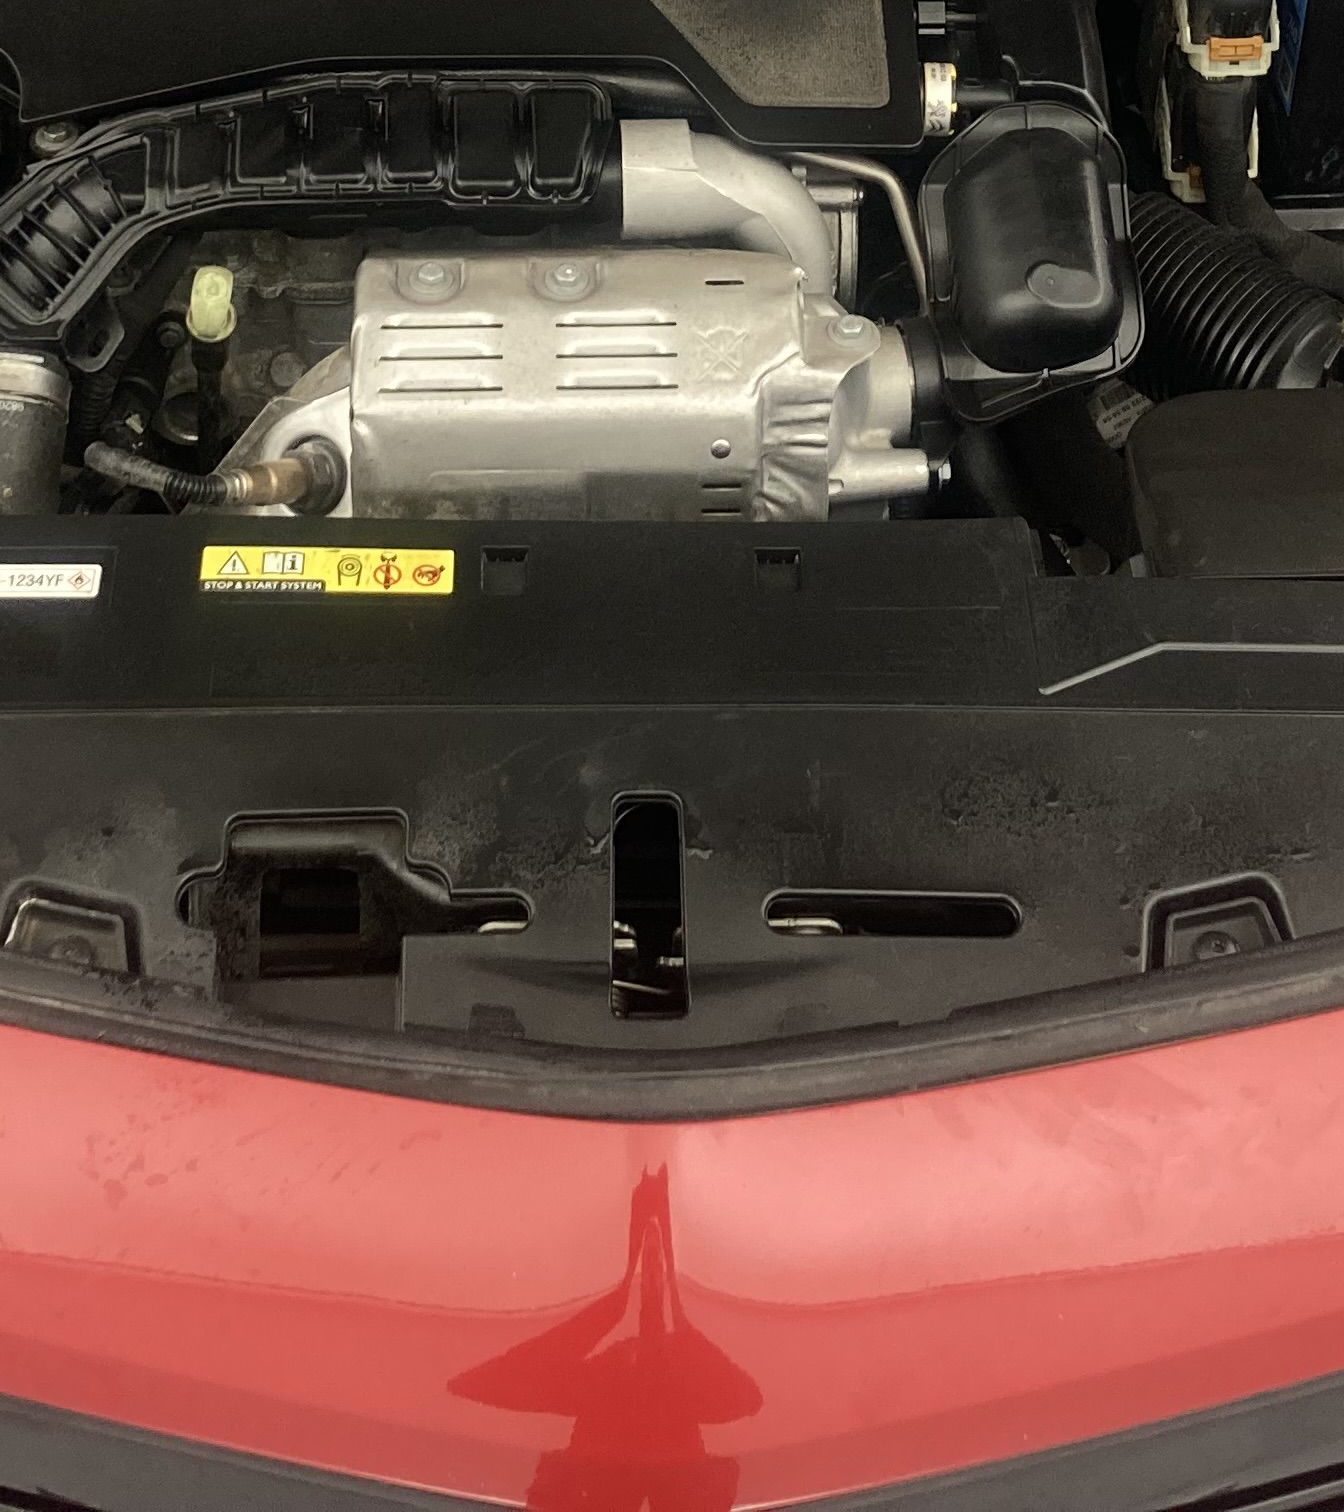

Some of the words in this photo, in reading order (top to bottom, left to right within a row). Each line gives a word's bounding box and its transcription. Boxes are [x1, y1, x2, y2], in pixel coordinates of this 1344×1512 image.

[203, 580, 234, 590] STOP
[234, 581, 243, 590] &
[244, 581, 277, 590] START
[280, 581, 322, 591] SYSTEM
